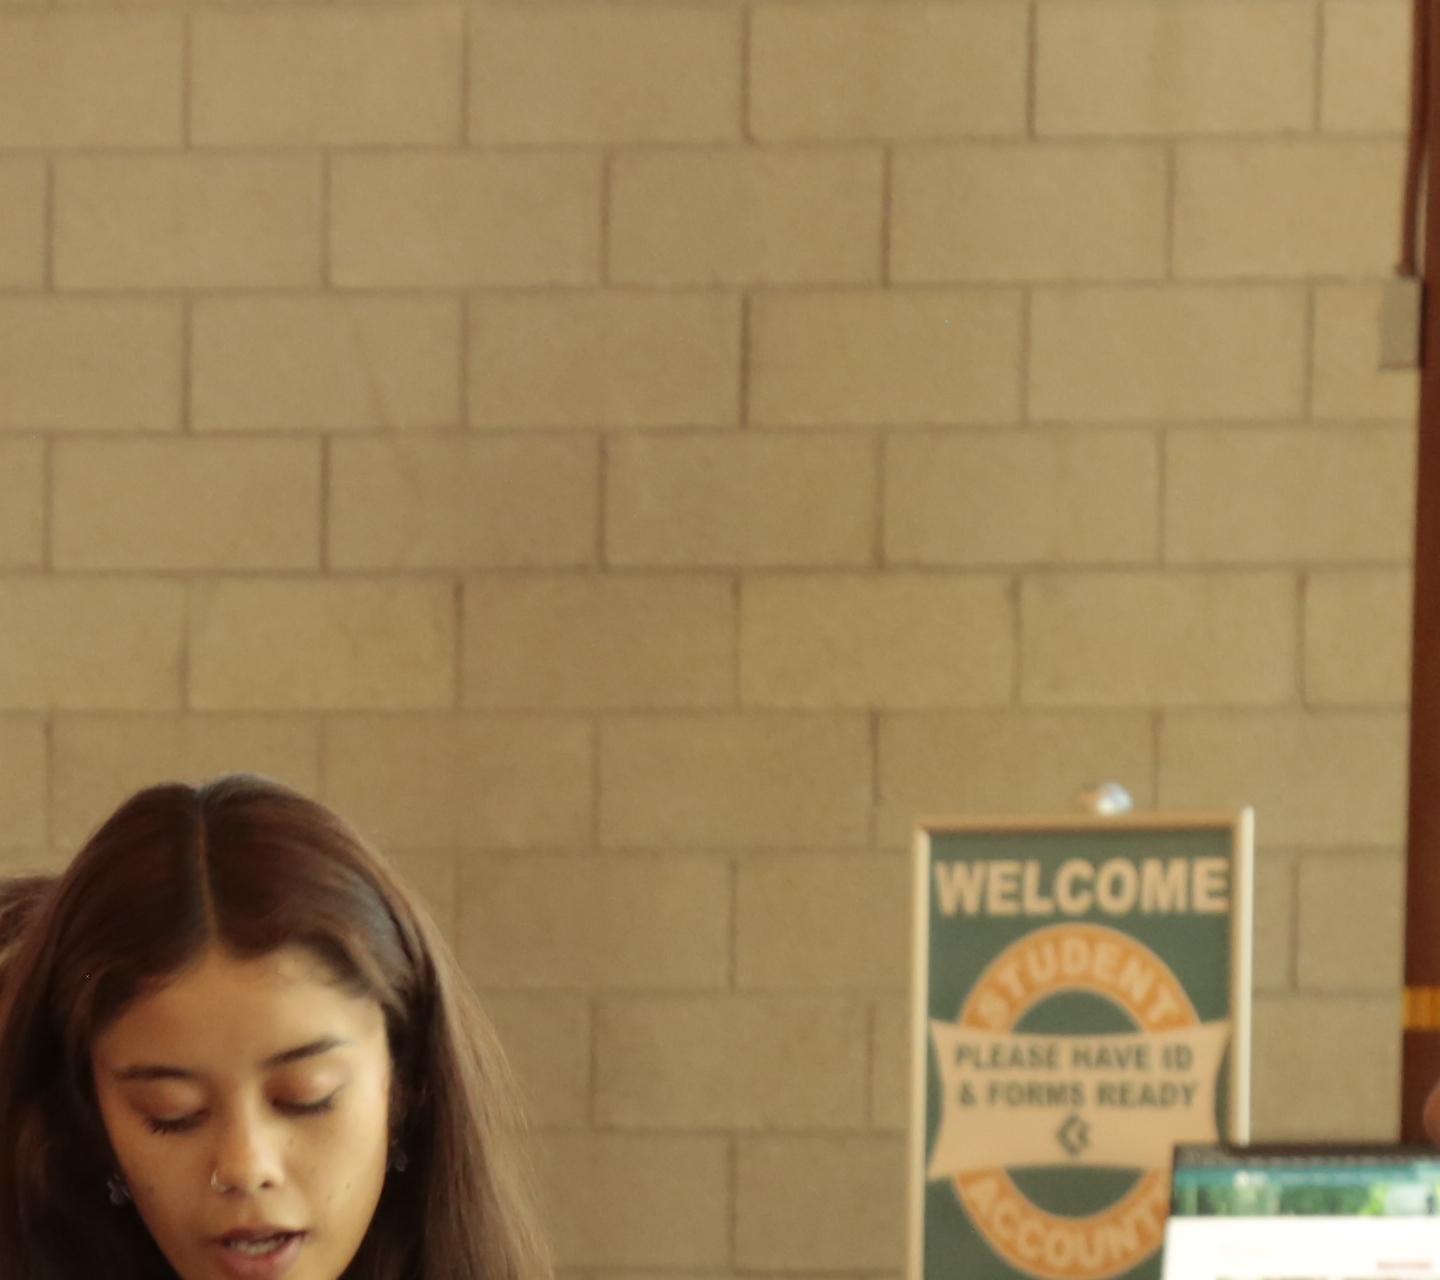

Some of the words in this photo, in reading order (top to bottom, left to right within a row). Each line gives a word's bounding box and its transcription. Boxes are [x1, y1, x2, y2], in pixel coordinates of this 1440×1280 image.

[936, 857, 1230, 917] WELCOME
[980, 935, 1182, 1030] STUDENT
[954, 1044, 1060, 1071] PLEASE
[1072, 1044, 1149, 1071] HAVE
[1163, 1045, 1194, 1071] ID
[958, 1083, 977, 1108] &
[987, 1082, 1087, 1109] FORMS
[1096, 1082, 1199, 1109] READY
[966, 1176, 1170, 1269] ACCOUNT
